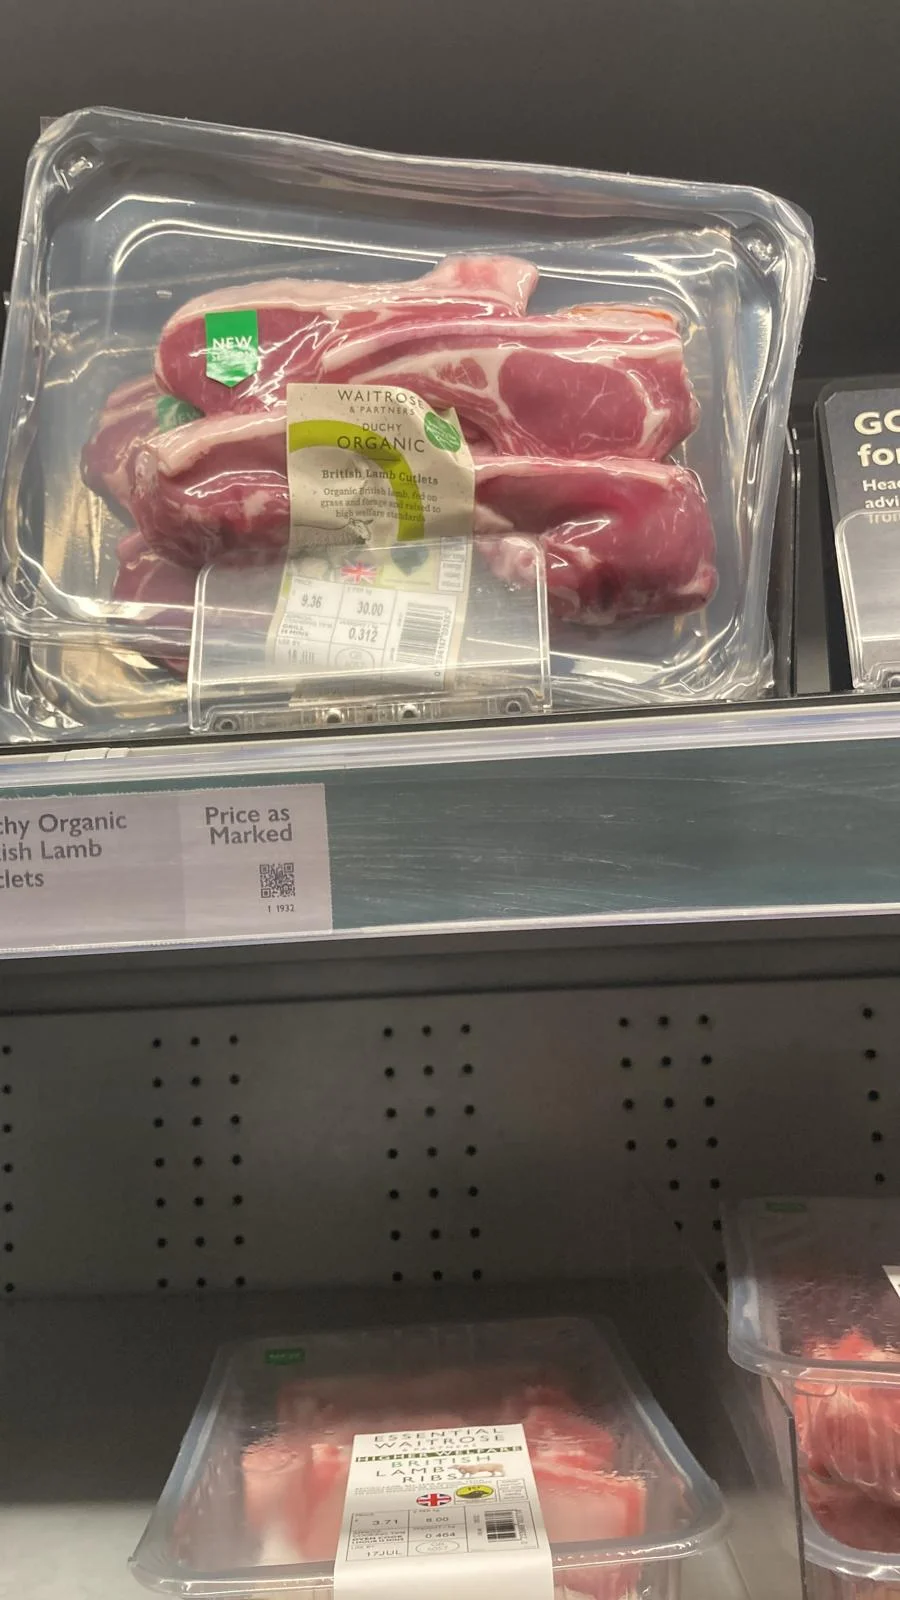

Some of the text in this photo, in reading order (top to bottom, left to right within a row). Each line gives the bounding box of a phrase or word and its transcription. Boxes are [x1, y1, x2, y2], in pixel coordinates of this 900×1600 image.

[212, 335, 252, 350] NEW
[337, 389, 425, 410] WAITROSE
[349, 403, 416, 416] & PARTNERS
[362, 422, 402, 433] DUCHY
[336, 435, 426, 453] ORGANIC
[322, 469, 439, 486] British Lamb Cutlets
[323, 487, 357, 497] Organic
[335, 509, 354, 520] high
[301, 593, 322, 609] 9.36
[357, 600, 384, 617] 30.00
[348, 627, 378, 643] 0.312
[205, 806, 290, 825] Price as
[38, 811, 128, 838] Organic
[210, 823, 293, 845] Marked
[0, 838, 103, 863] ish Lamb
[276, 903, 296, 913] 1932
[374, 1427, 504, 1443] ESSENTIAL
[374, 1434, 506, 1449] WAITROSE
[391, 1454, 492, 1468] BRITISH
[376, 1466, 445, 1477] LAMB
[402, 1473, 458, 1484] RIBS
